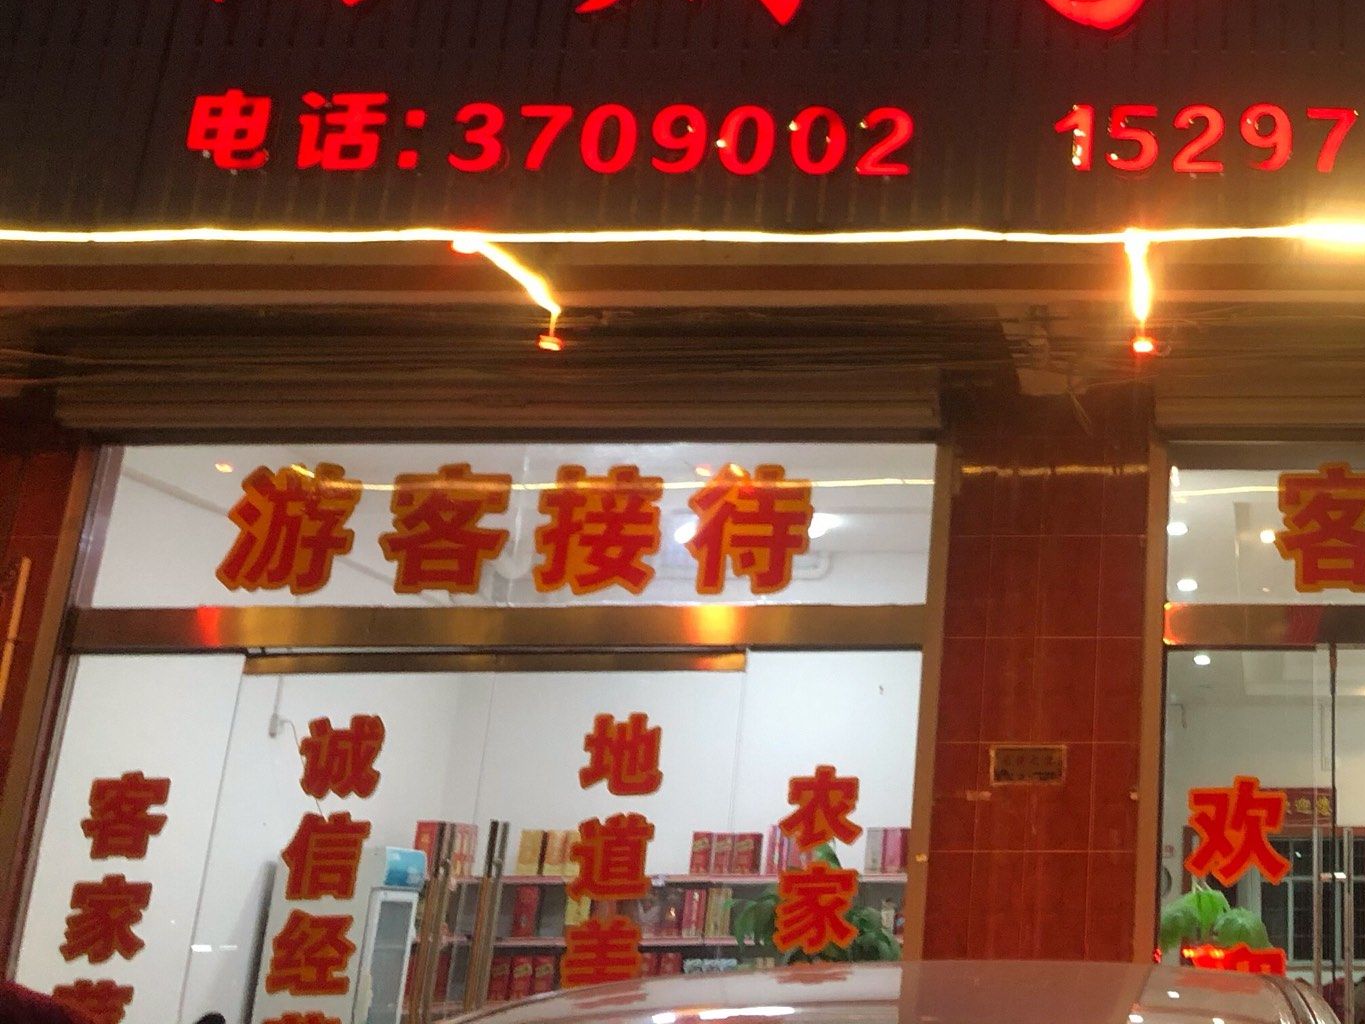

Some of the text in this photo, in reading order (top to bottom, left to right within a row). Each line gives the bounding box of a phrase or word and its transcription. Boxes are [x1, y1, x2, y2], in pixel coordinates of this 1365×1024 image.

[215, 463, 815, 595] 游客接待
[260, 714, 385, 1024] 诚信经
